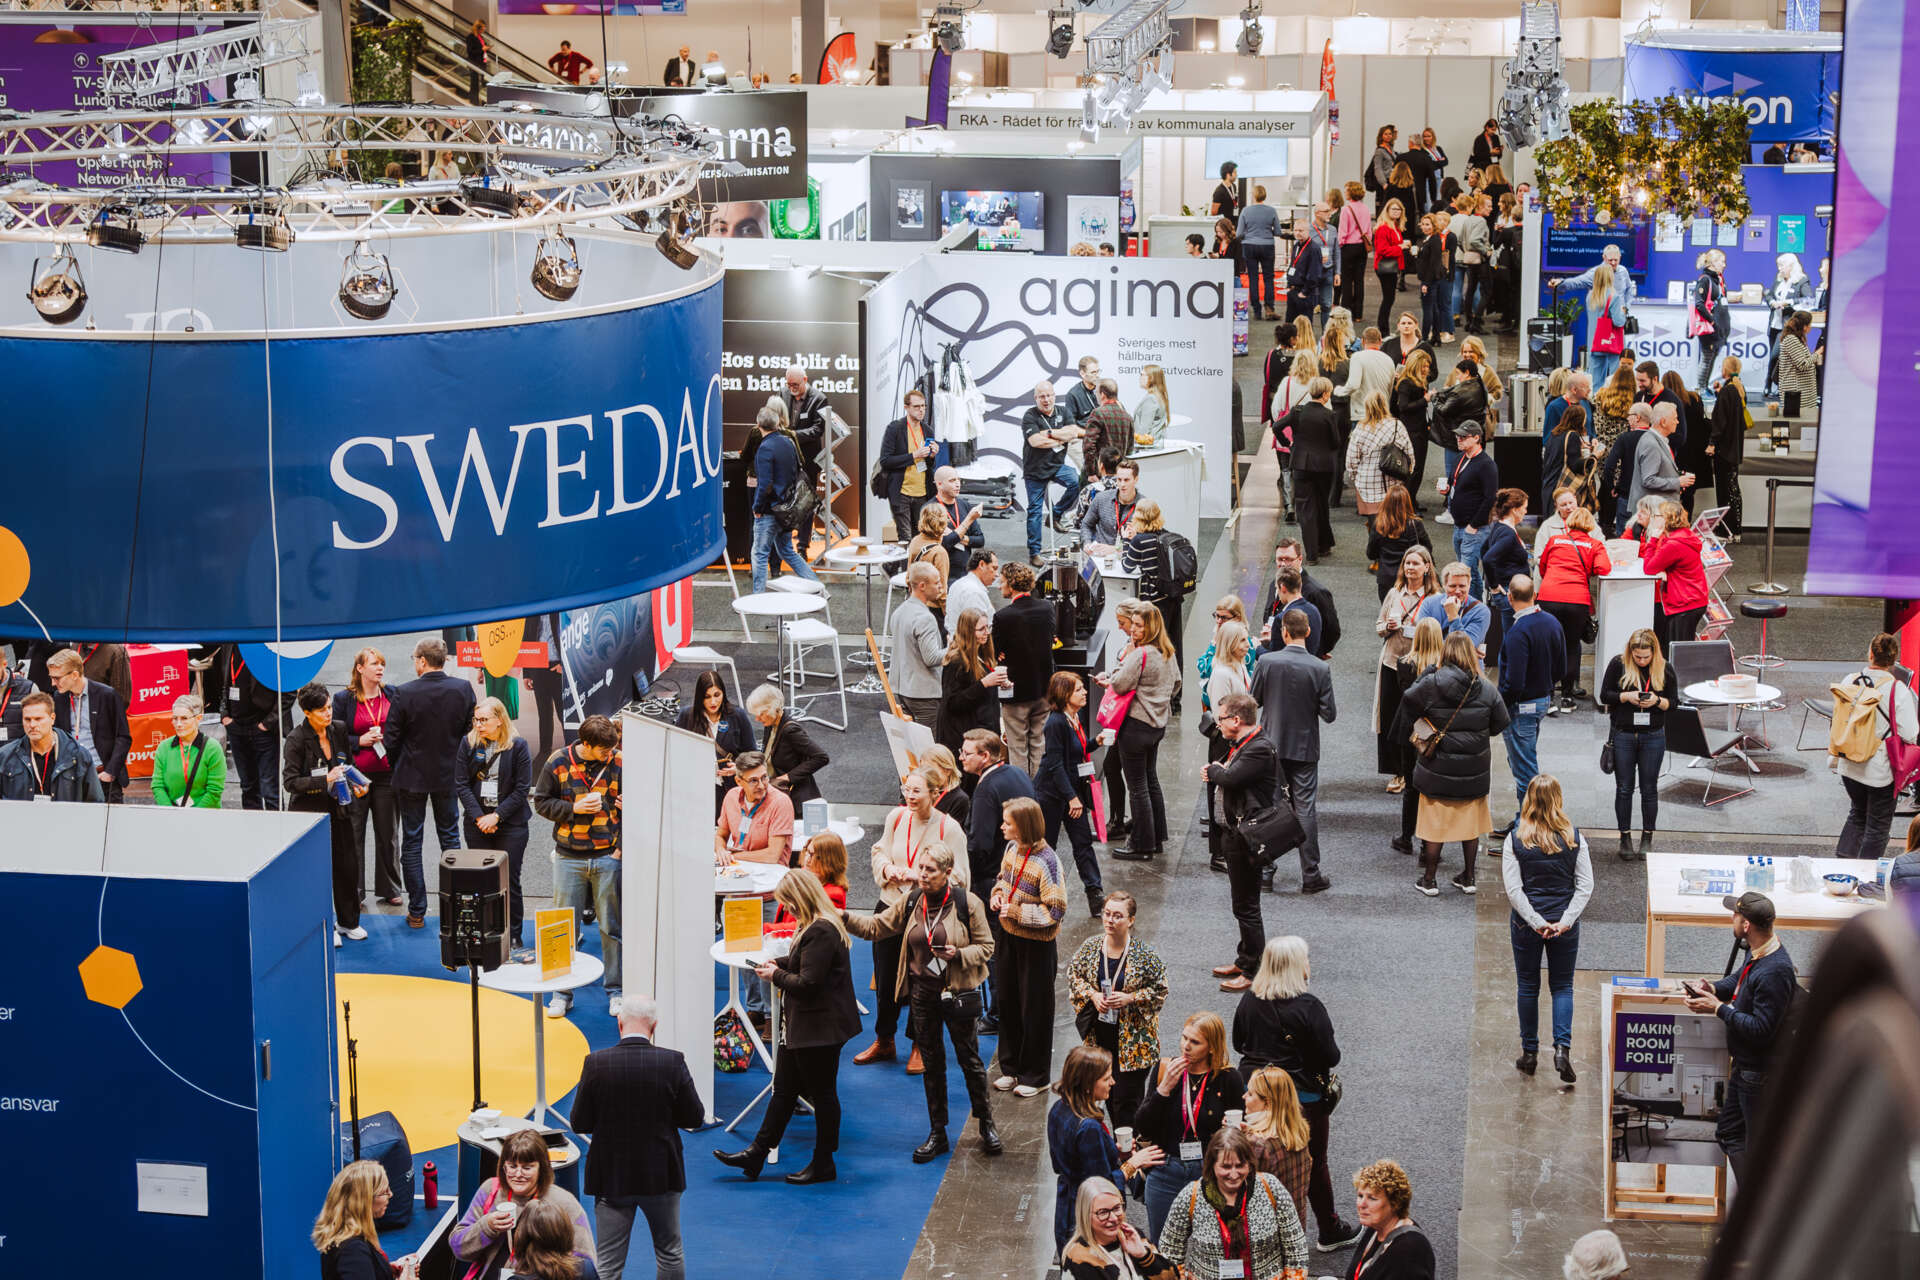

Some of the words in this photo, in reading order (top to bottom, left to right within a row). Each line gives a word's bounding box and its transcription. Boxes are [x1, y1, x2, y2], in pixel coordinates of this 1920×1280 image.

[74, 93, 115, 106] Lunch
[959, 114, 989, 128] RKA
[1046, 115, 1064, 129] för
[1137, 120, 1153, 130] av
[1157, 117, 1235, 131] kommunala
[1238, 118, 1296, 134] analyser
[1020, 265, 1225, 335] agima
[1118, 338, 1166, 350] Sveriges
[1169, 340, 1196, 350] mest
[722, 352, 754, 369] Hos
[759, 355, 791, 369] oss
[796, 353, 831, 370] blir
[835, 354, 860, 371] du
[1118, 352, 1162, 362] hållbara
[722, 377, 742, 391] en
[747, 375, 787, 392] bätt
[812, 377, 859, 393] chef.
[329, 373, 723, 550] SWEDAC
[139, 685, 170, 702] pwc
[1626, 1022, 1683, 1036] MAKING
[1626, 1037, 1670, 1050] ROOM
[1625, 1051, 1654, 1064] FOR
[1657, 1053, 1684, 1065] LIFE
[0, 1097, 60, 1112] ansvar
